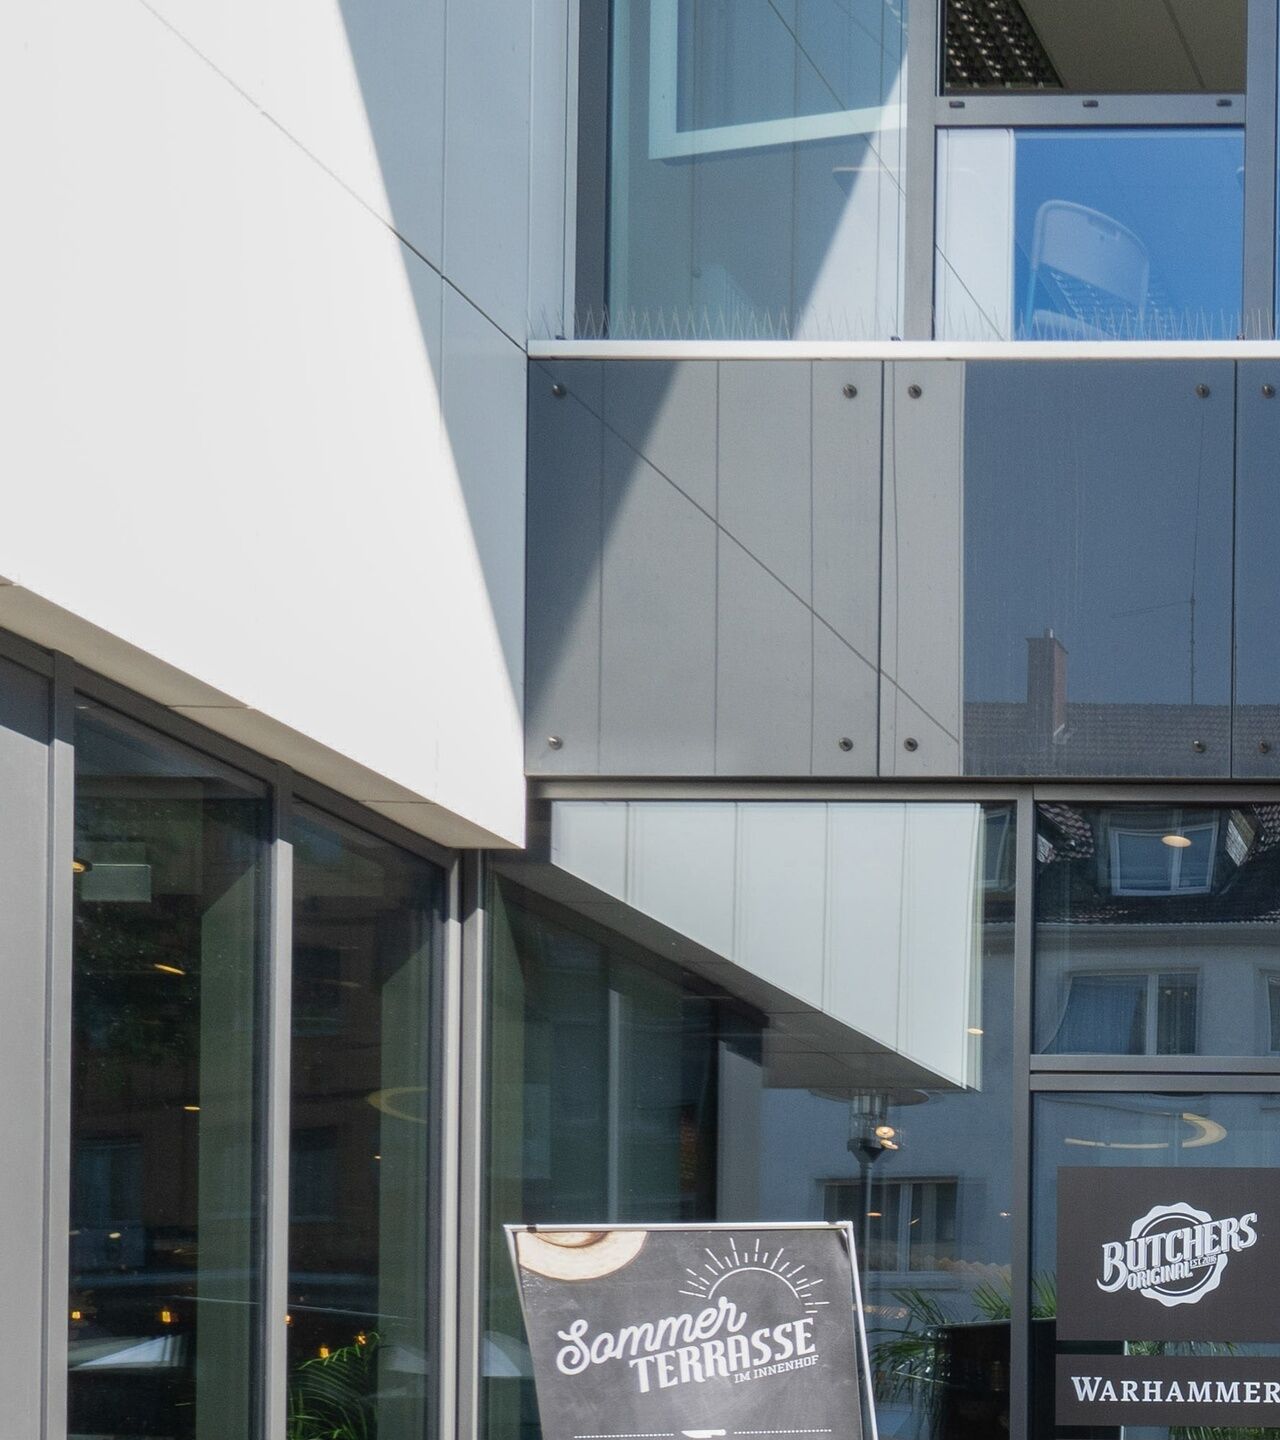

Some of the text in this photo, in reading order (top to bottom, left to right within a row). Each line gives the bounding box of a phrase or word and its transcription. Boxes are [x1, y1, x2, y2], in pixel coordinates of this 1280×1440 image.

[1096, 1212, 1259, 1293] BUTCHERS
[1127, 1262, 1194, 1291] ORIGINAL
[556, 1296, 748, 1375] Sommer
[629, 1318, 816, 1393] TERRASSE
[734, 1355, 819, 1384] IM INNENHOF
